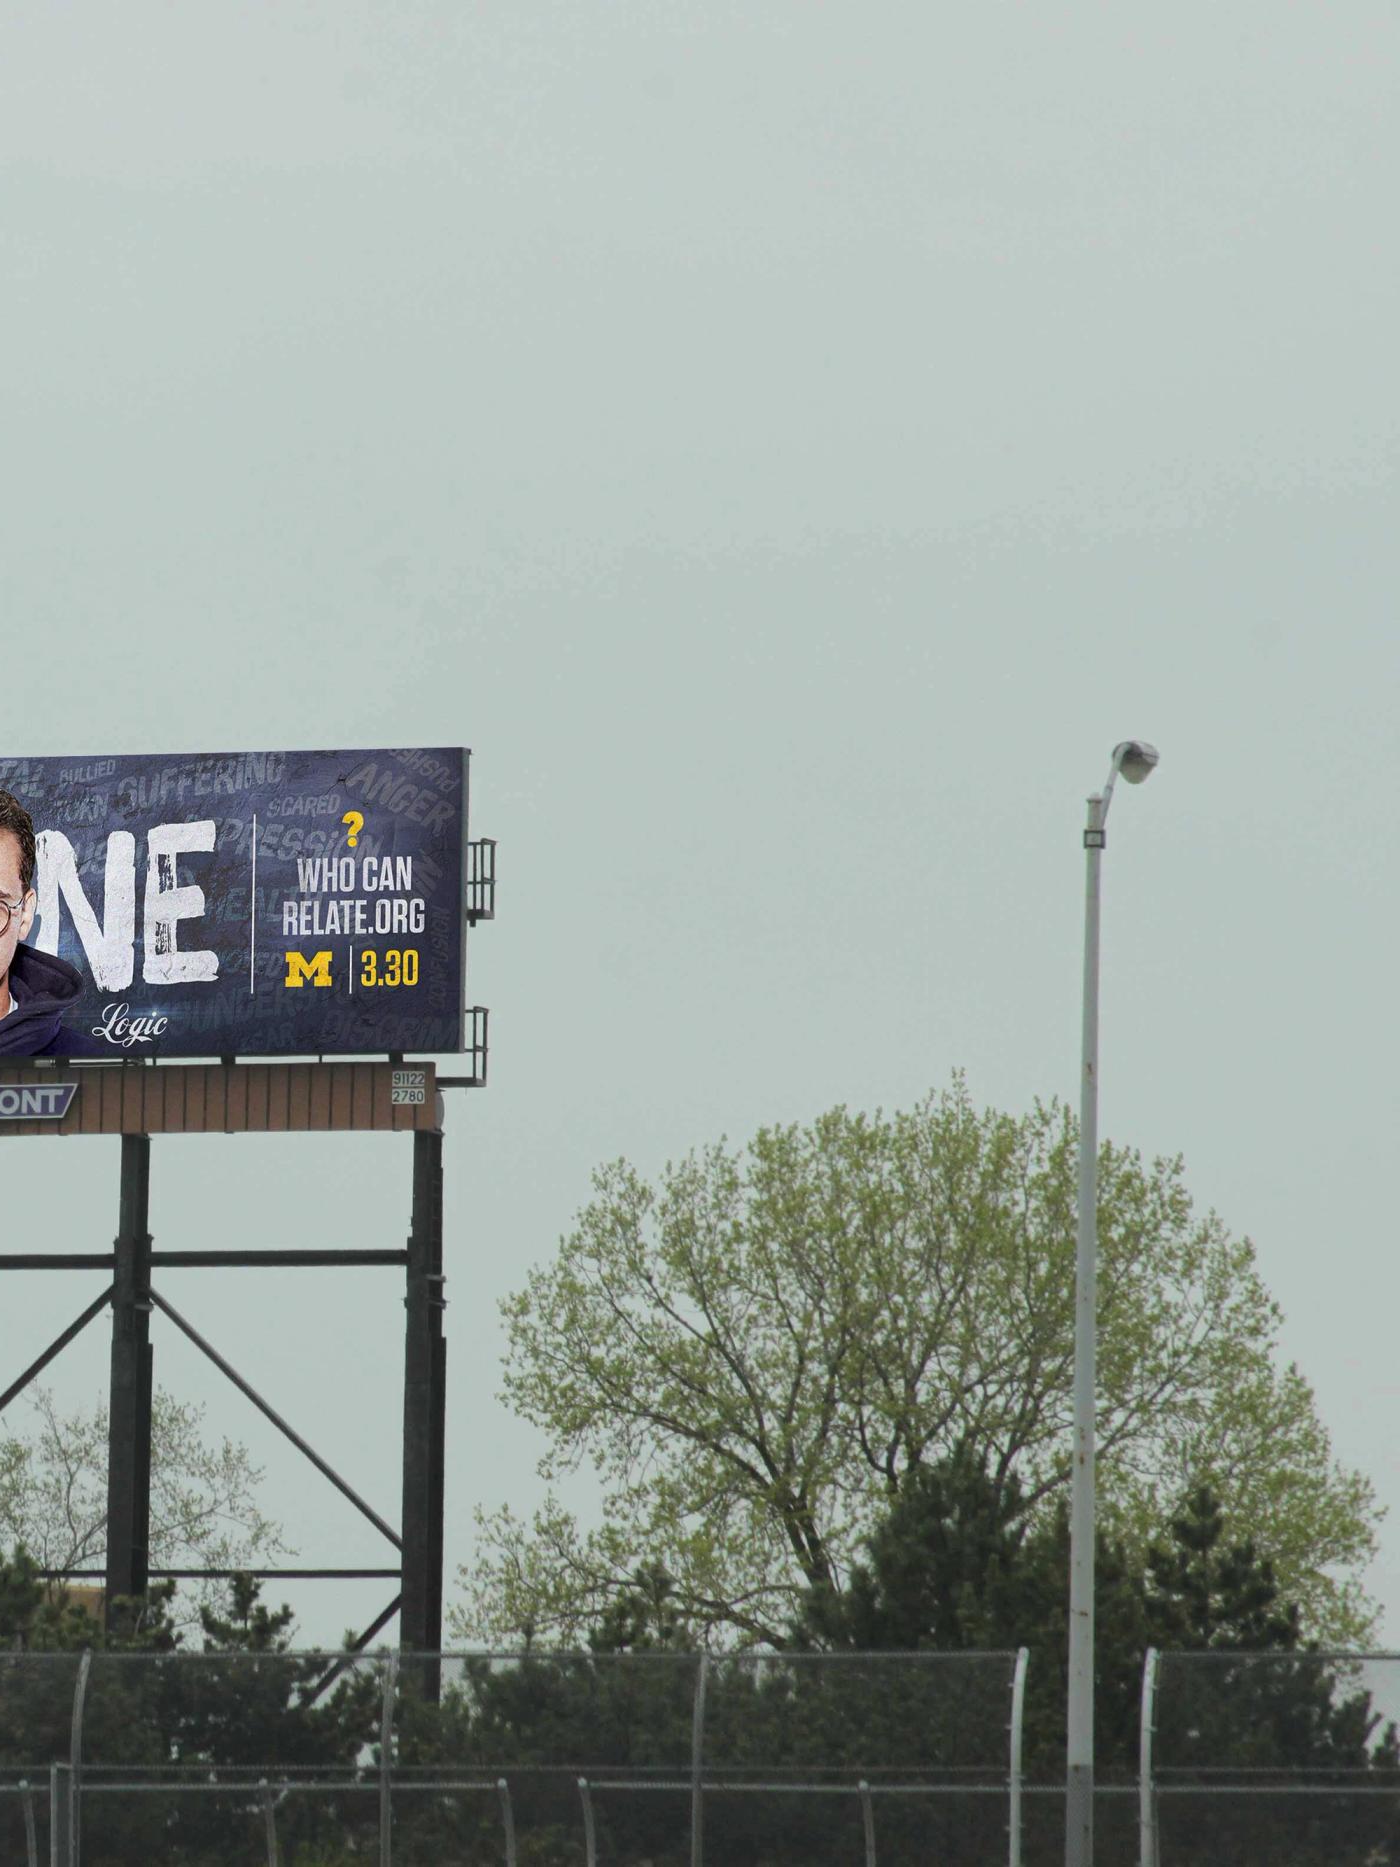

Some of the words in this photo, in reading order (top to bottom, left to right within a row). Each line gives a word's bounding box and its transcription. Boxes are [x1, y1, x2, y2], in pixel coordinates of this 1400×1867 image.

[342, 810, 365, 848] ?
[297, 856, 356, 893] WHO
[362, 855, 413, 892] CAN
[282, 898, 426, 936] RELATE.ORG
[284, 951, 333, 987] M
[360, 949, 419, 987] 3.30
[91, 1002, 168, 1048] Logic
[393, 1072, 425, 1085] 91122
[393, 1090, 424, 1102] 2780
